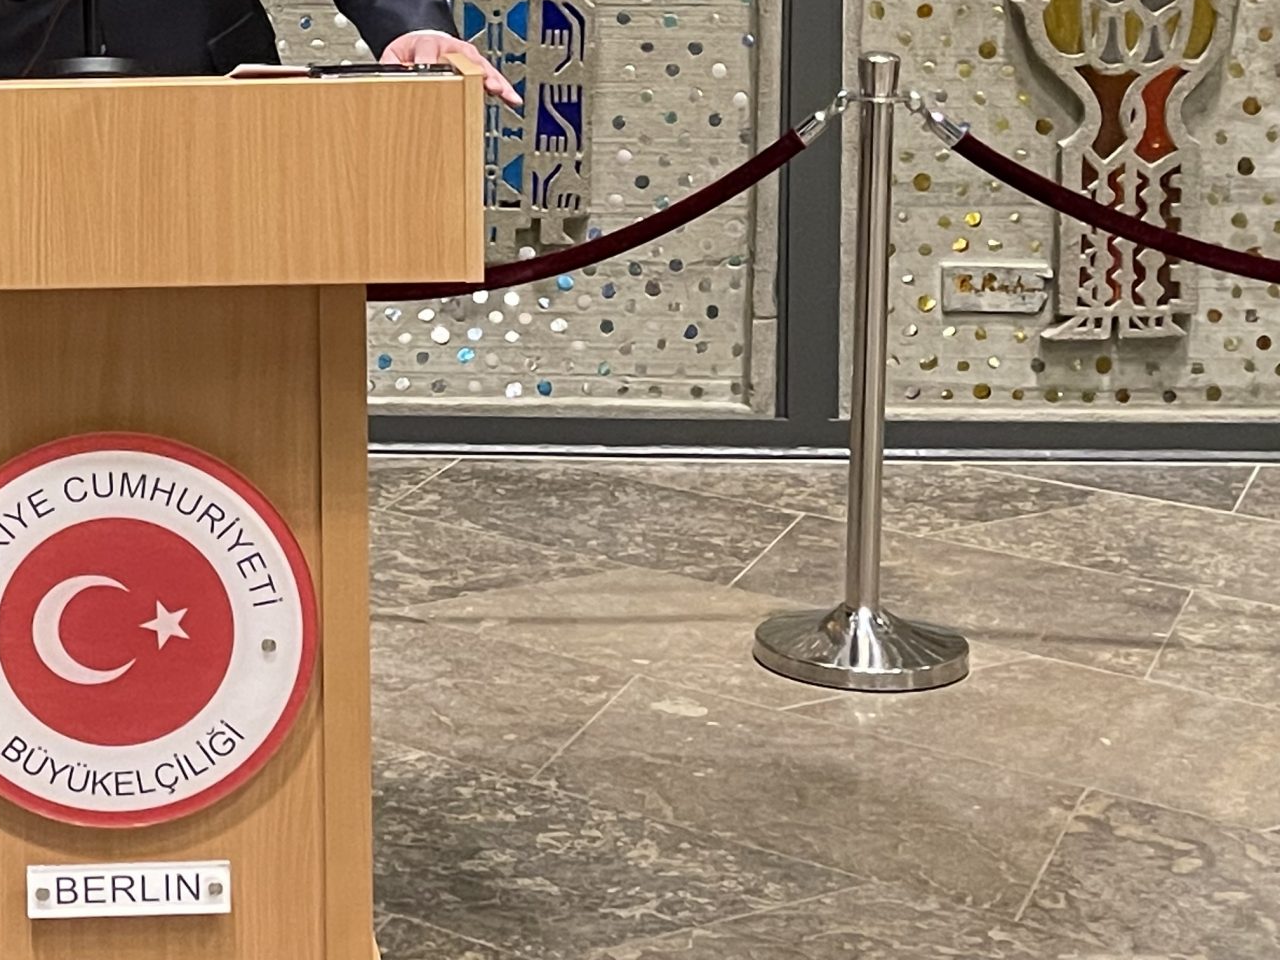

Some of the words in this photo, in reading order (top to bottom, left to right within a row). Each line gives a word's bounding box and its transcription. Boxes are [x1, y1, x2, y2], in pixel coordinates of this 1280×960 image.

[62, 471, 284, 609] CUMHURİYETİ
[0, 719, 246, 797] BÜYÜKELÇİLİĞİ
[55, 872, 201, 905] BERLIN
